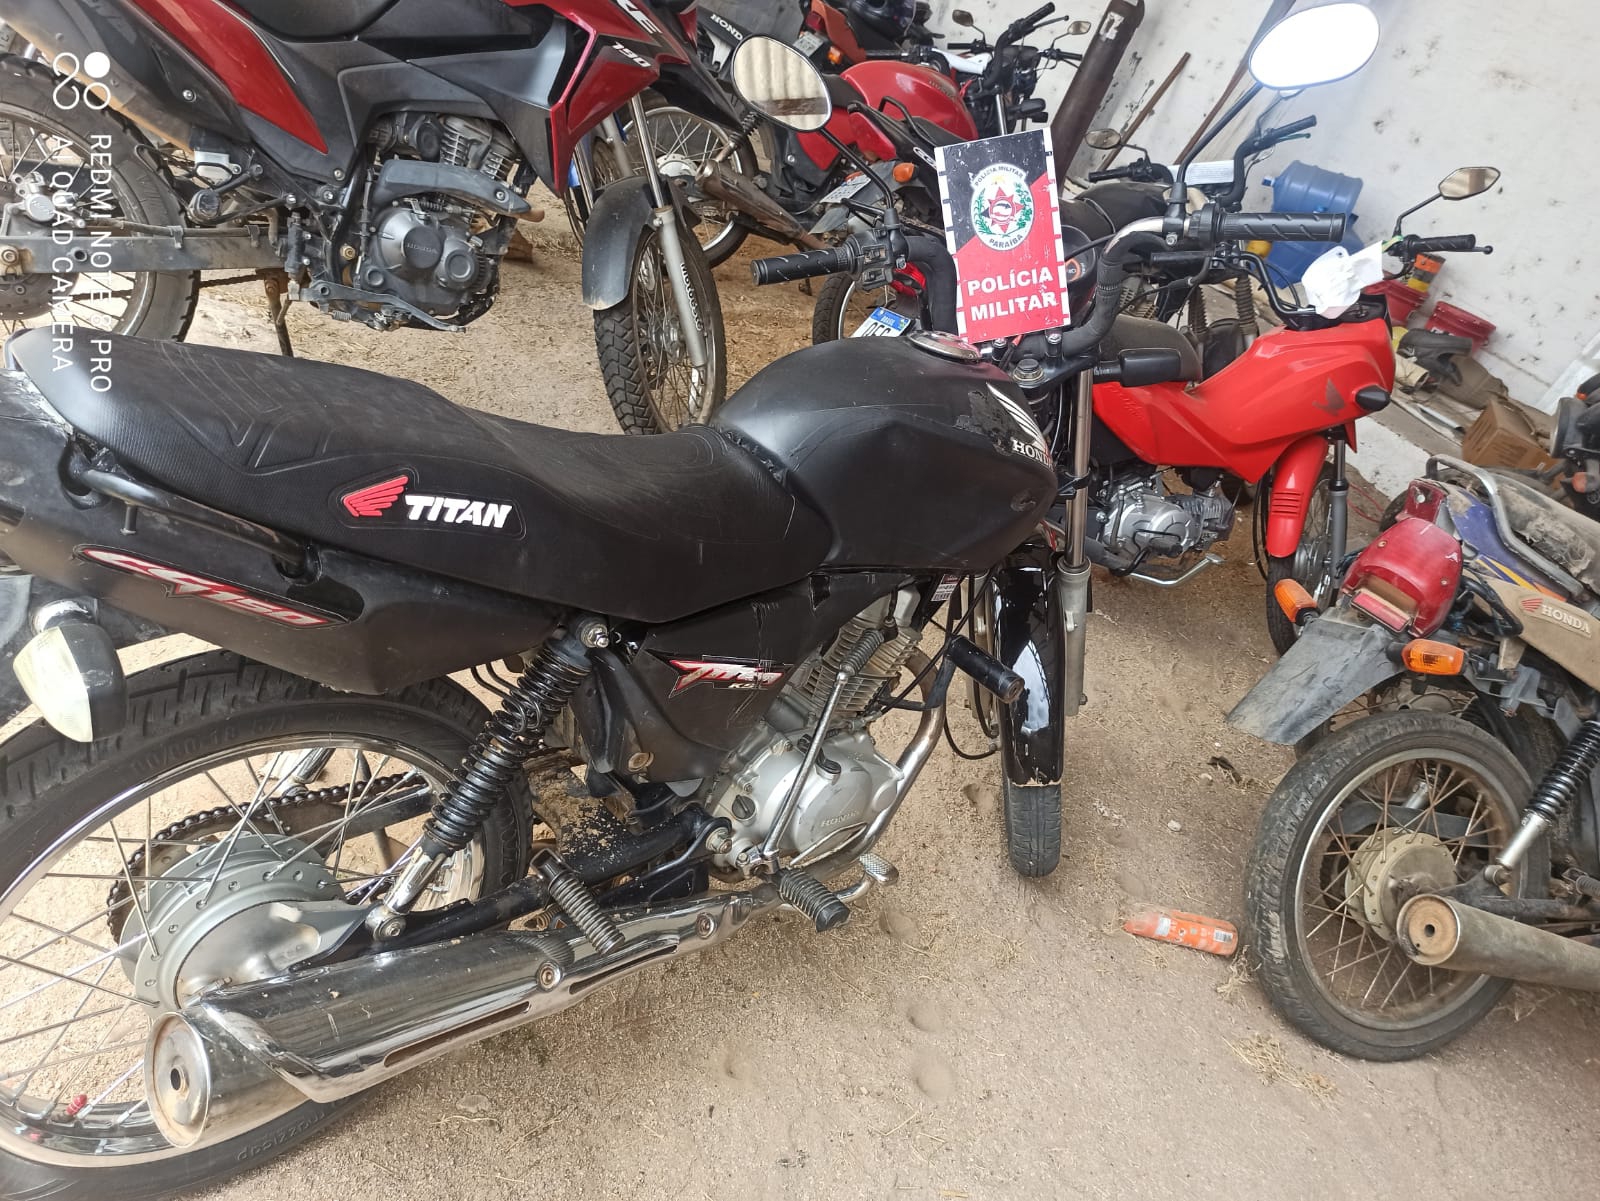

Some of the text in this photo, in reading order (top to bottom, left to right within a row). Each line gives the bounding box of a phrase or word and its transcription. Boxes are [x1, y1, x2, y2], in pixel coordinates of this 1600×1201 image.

[710, 14, 744, 41] HOND
[967, 266, 1054, 296] POLÍCIA
[970, 291, 1057, 321] MILITAR
[404, 494, 513, 528] TITAN
[1541, 604, 1591, 634] HONDA
